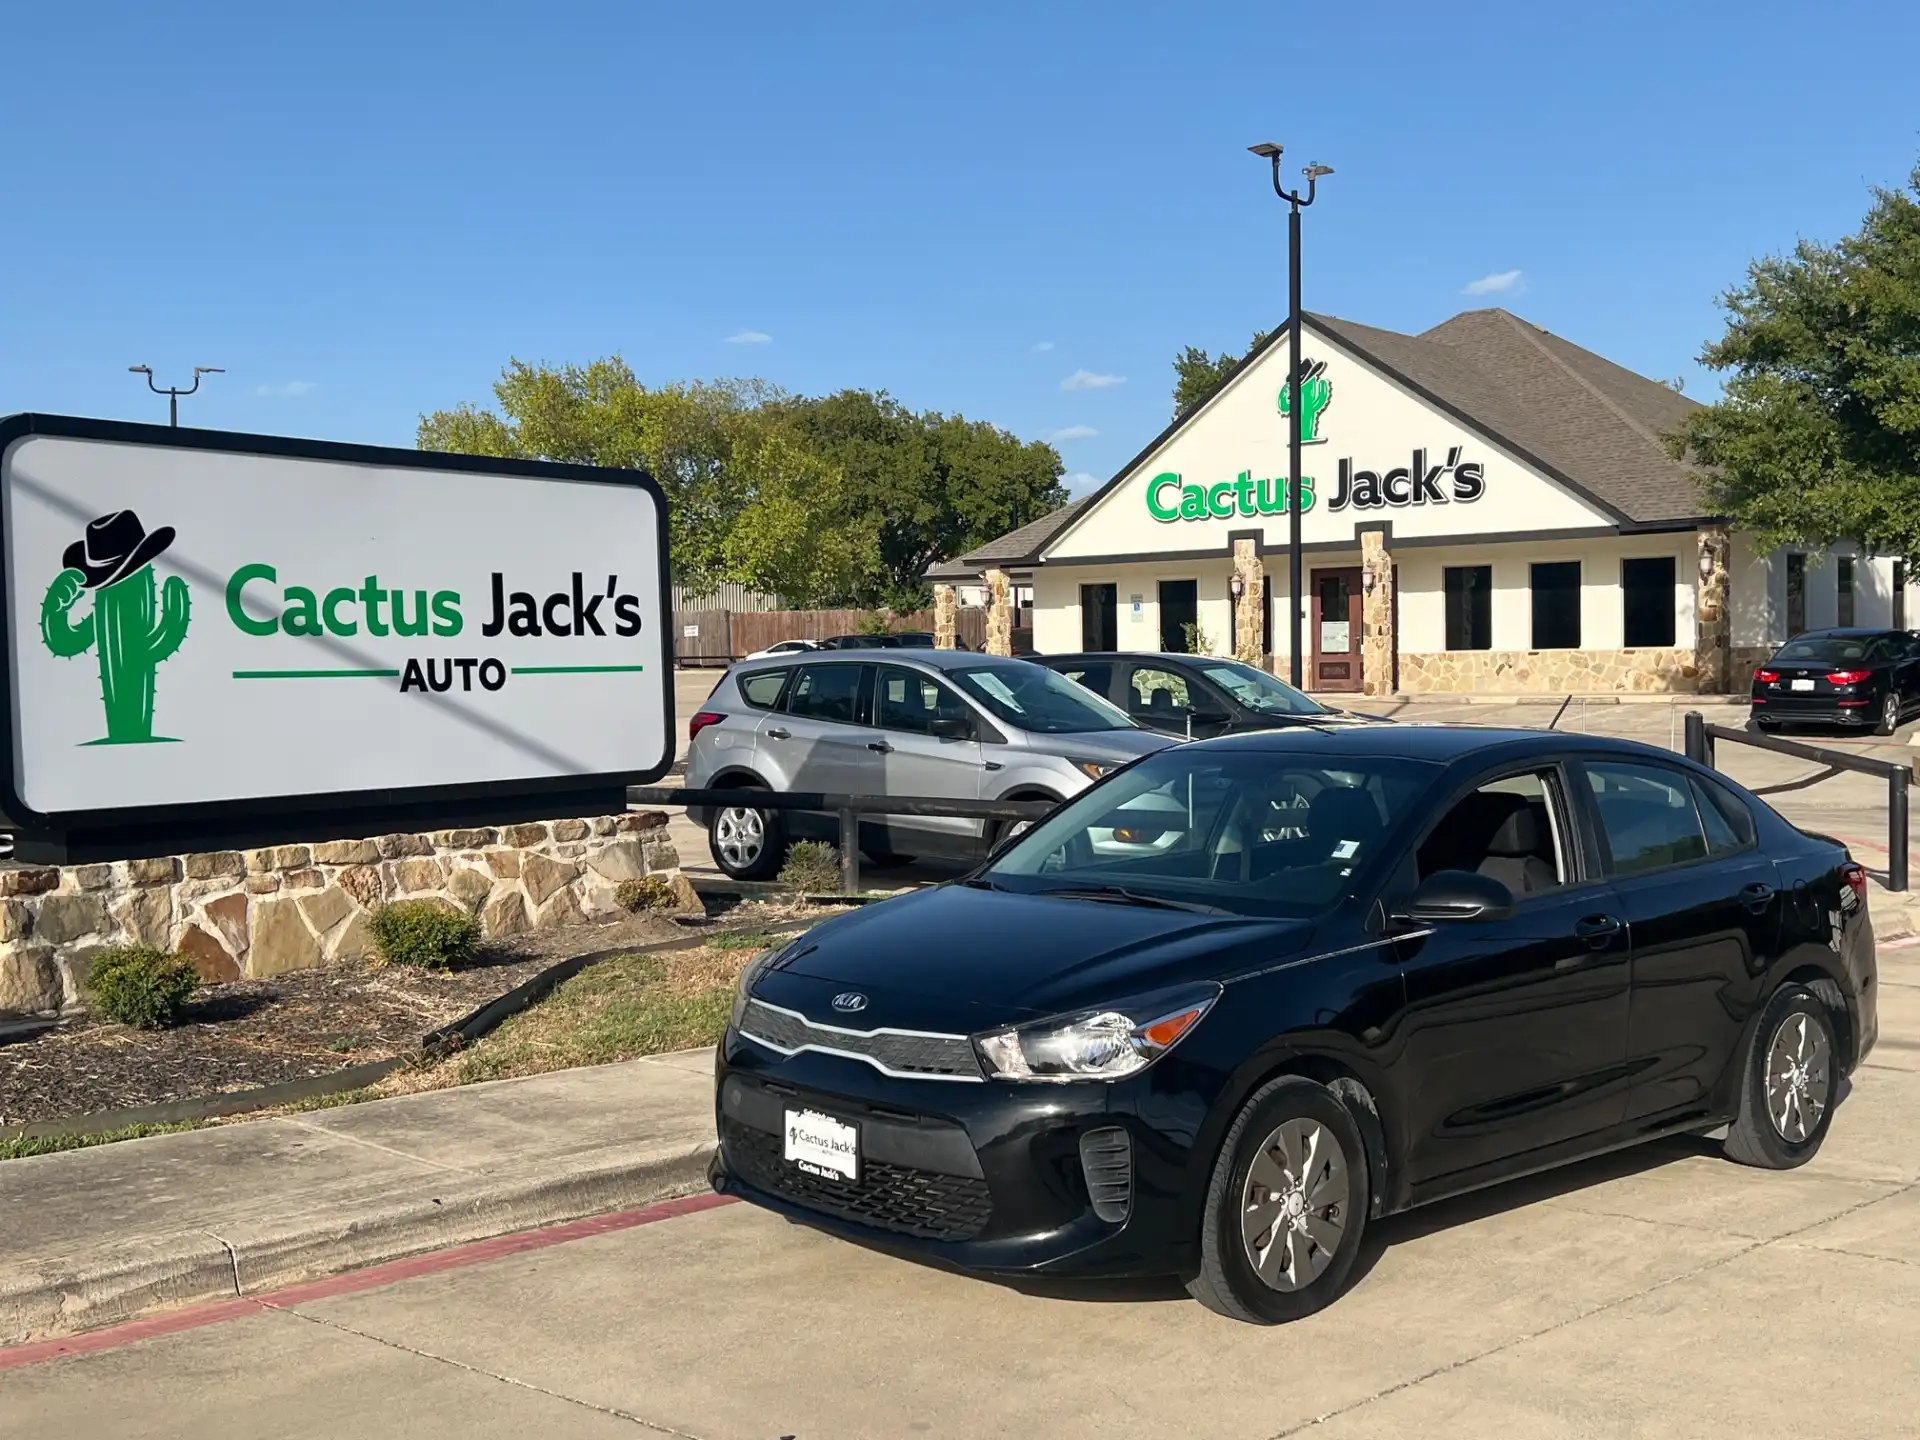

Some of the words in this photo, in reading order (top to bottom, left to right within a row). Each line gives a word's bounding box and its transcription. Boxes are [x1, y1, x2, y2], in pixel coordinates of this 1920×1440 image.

[1145, 471, 1316, 521] Cactus
[1328, 446, 1484, 510] Jack's
[226, 563, 463, 637] Cactus
[481, 571, 642, 637] Jack's
[399, 657, 507, 693] AUTO
[799, 1128, 829, 1149] Cactus
[831, 1136, 857, 1156] Jack's
